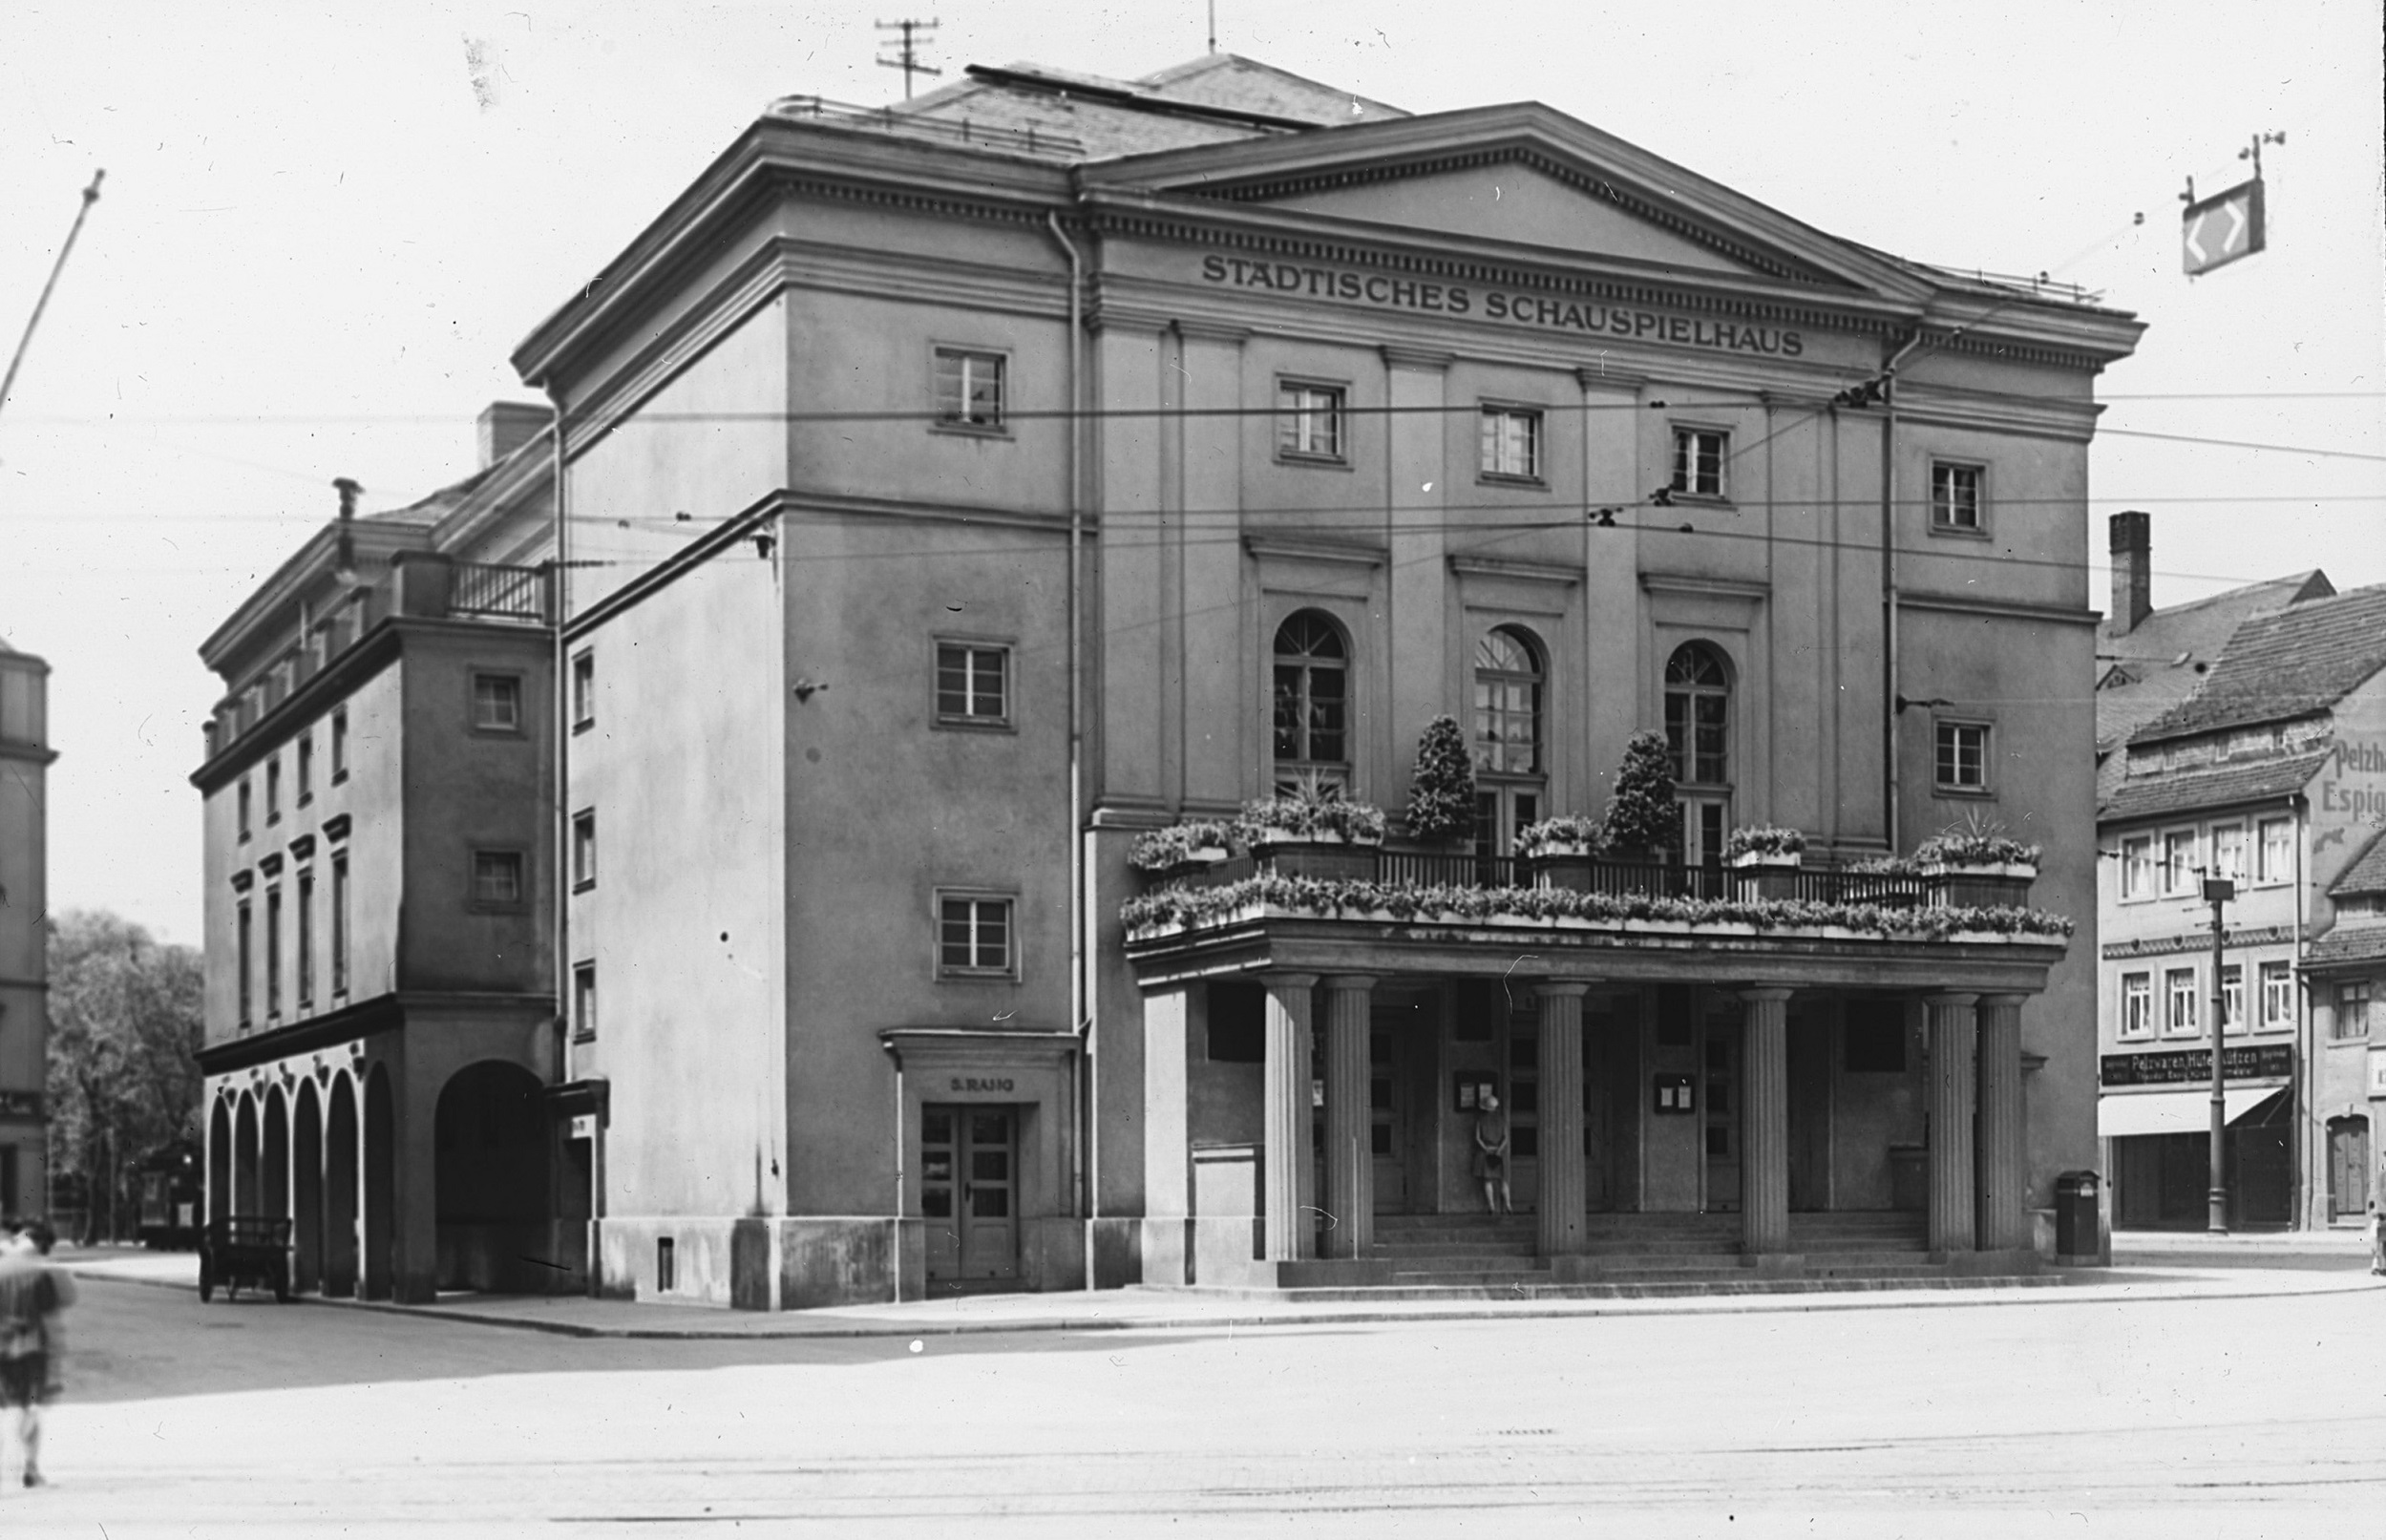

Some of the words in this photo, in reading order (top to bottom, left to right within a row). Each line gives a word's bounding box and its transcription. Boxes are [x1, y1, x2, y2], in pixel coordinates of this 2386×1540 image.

[1202, 254, 1471, 314] STÄDTISCHES
[1485, 291, 1805, 357] SCHAUSPIELHAUS
[2334, 739, 2386, 779] Pelzh
